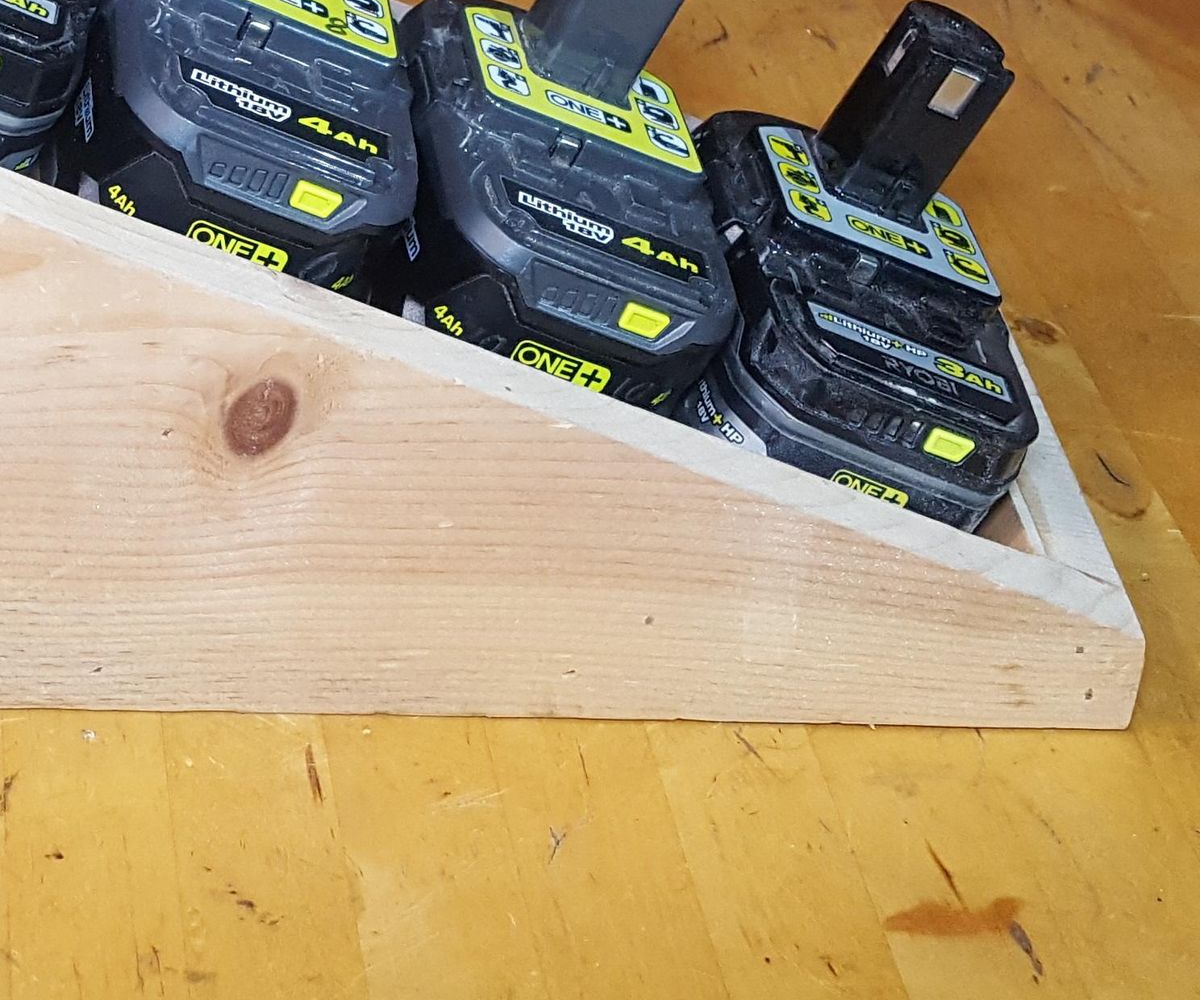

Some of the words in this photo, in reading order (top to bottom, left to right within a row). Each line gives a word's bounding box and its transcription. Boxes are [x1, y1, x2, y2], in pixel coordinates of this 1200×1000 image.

[191, 69, 291, 116] Lithium
[299, 116, 378, 154] 4Ah
[237, 97, 286, 122] 18V
[108, 185, 136, 216] 4Ah
[519, 191, 614, 237] Lithium
[622, 237, 698, 273] 4Ah
[563, 219, 610, 243] 18V
[433, 305, 463, 336] 4Ah
[885, 359, 959, 396] RYOBI
[904, 343, 929, 358] HP
[934, 357, 1004, 395] 3Ah
[720, 421, 744, 445] HP
